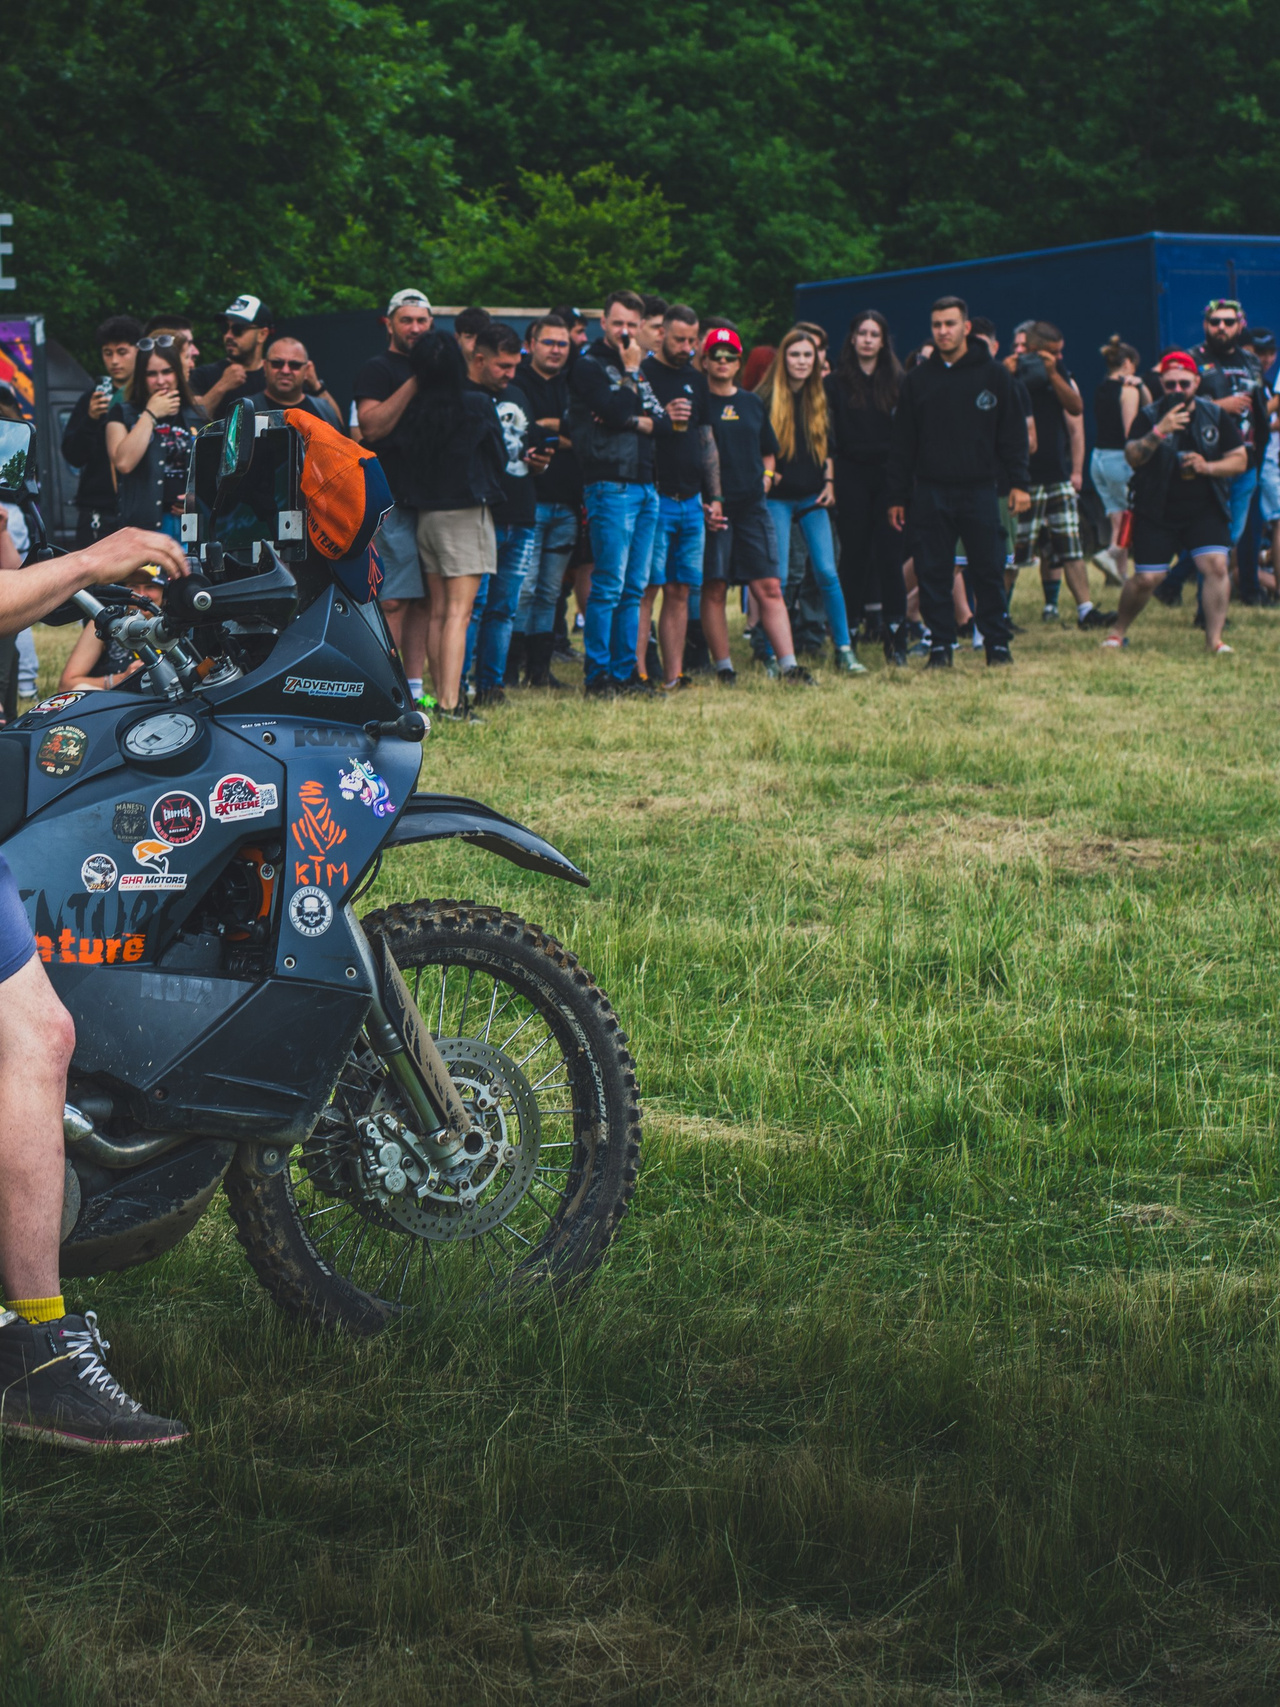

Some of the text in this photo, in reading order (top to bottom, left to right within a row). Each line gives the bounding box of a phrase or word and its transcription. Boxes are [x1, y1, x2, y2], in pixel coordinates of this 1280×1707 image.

[294, 725, 361, 748] KTM
[163, 806, 191, 821] CHOPPERS
[214, 799, 261, 817] EXTREME
[121, 876, 144, 885] SHR
